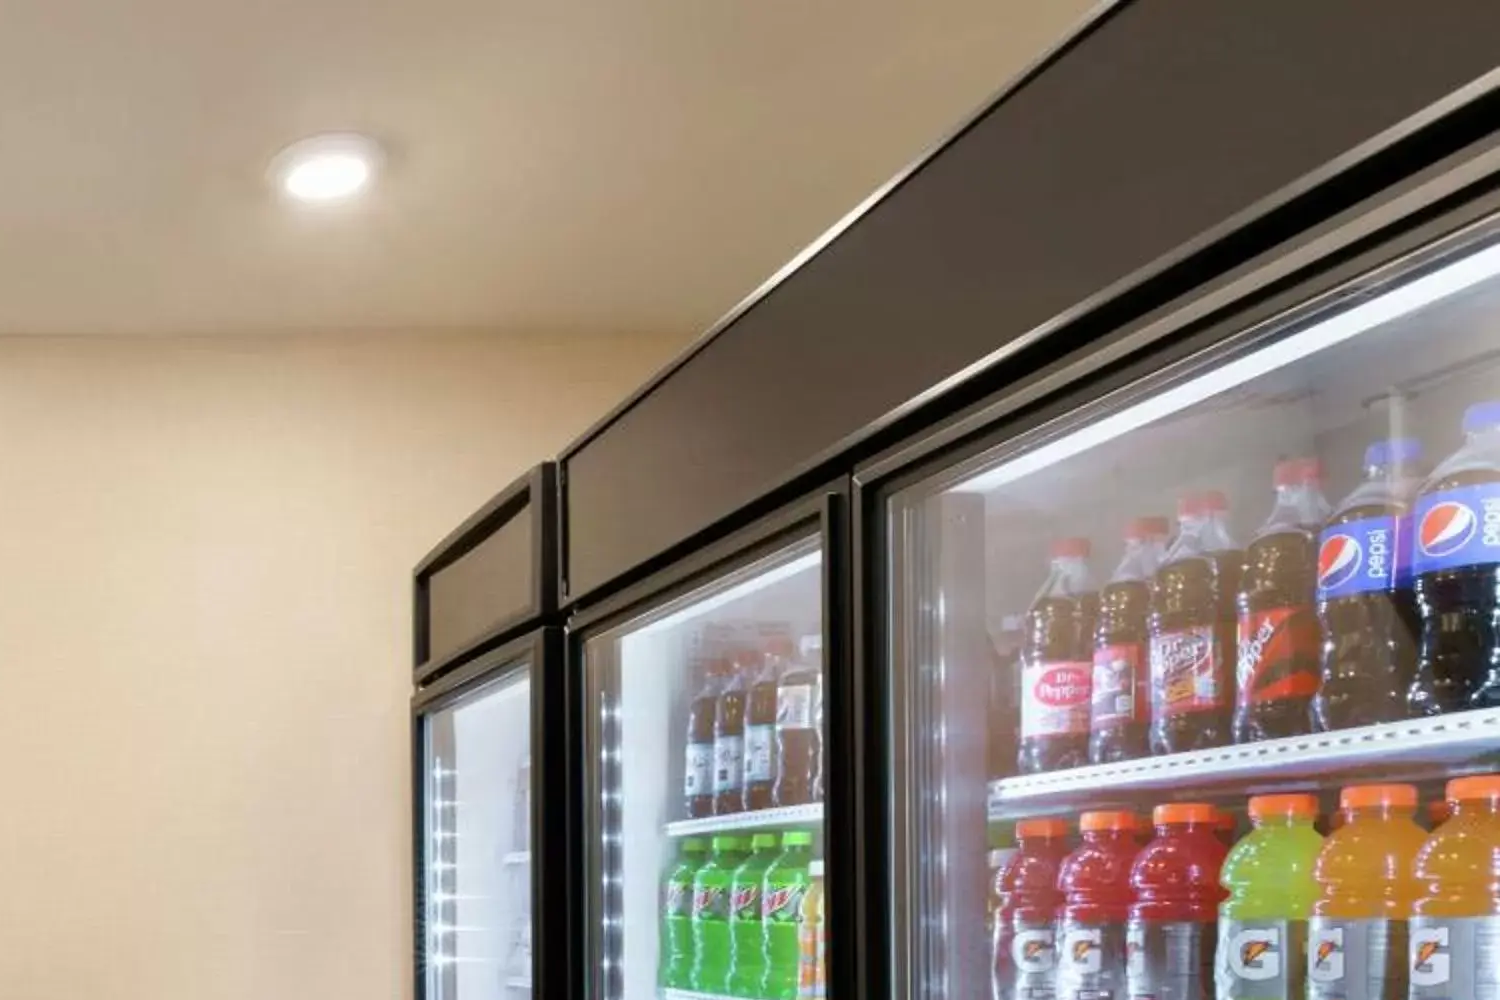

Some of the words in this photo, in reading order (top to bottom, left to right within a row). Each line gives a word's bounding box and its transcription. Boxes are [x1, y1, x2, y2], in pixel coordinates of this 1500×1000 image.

[1367, 527, 1388, 580] pepsi
[1229, 927, 1280, 981] G
[1409, 927, 1451, 987] G
